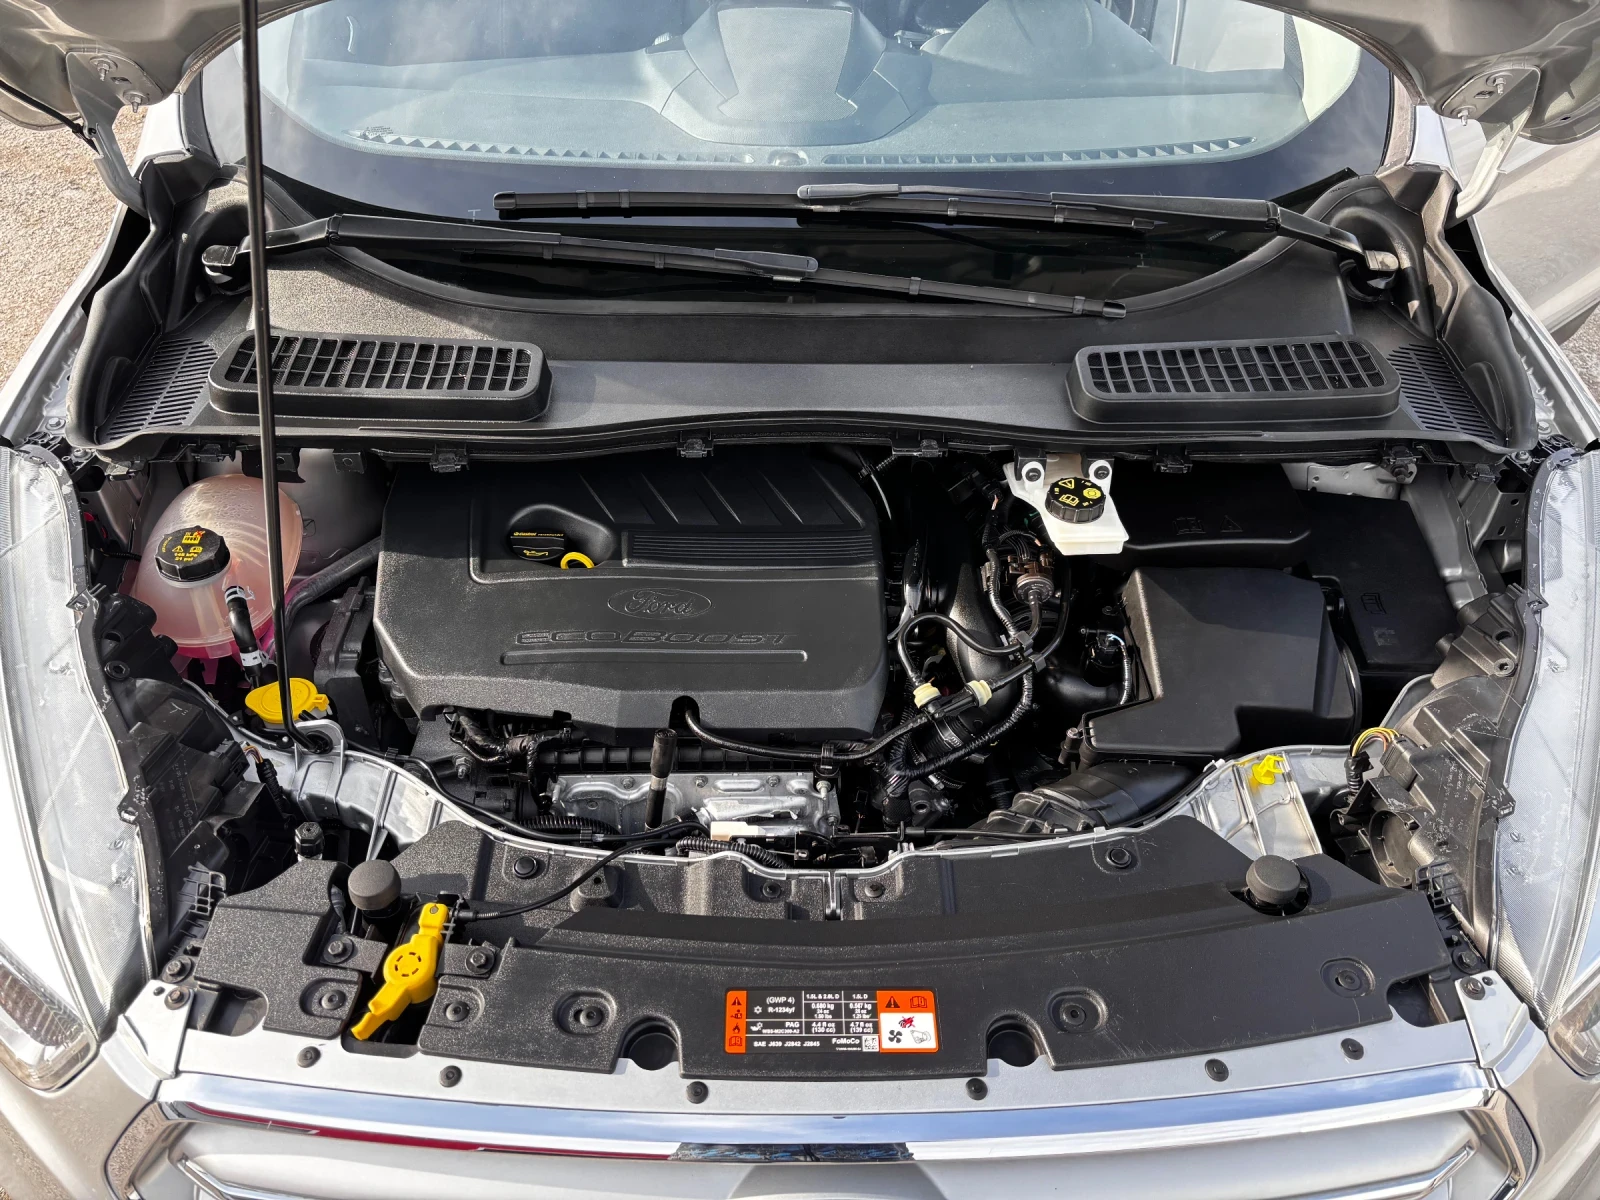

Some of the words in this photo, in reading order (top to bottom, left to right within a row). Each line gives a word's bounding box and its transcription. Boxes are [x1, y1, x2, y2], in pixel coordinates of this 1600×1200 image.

[624, 589, 694, 615] Ford
[766, 996, 787, 1004] (GWP
[787, 996, 795, 1004] 4)
